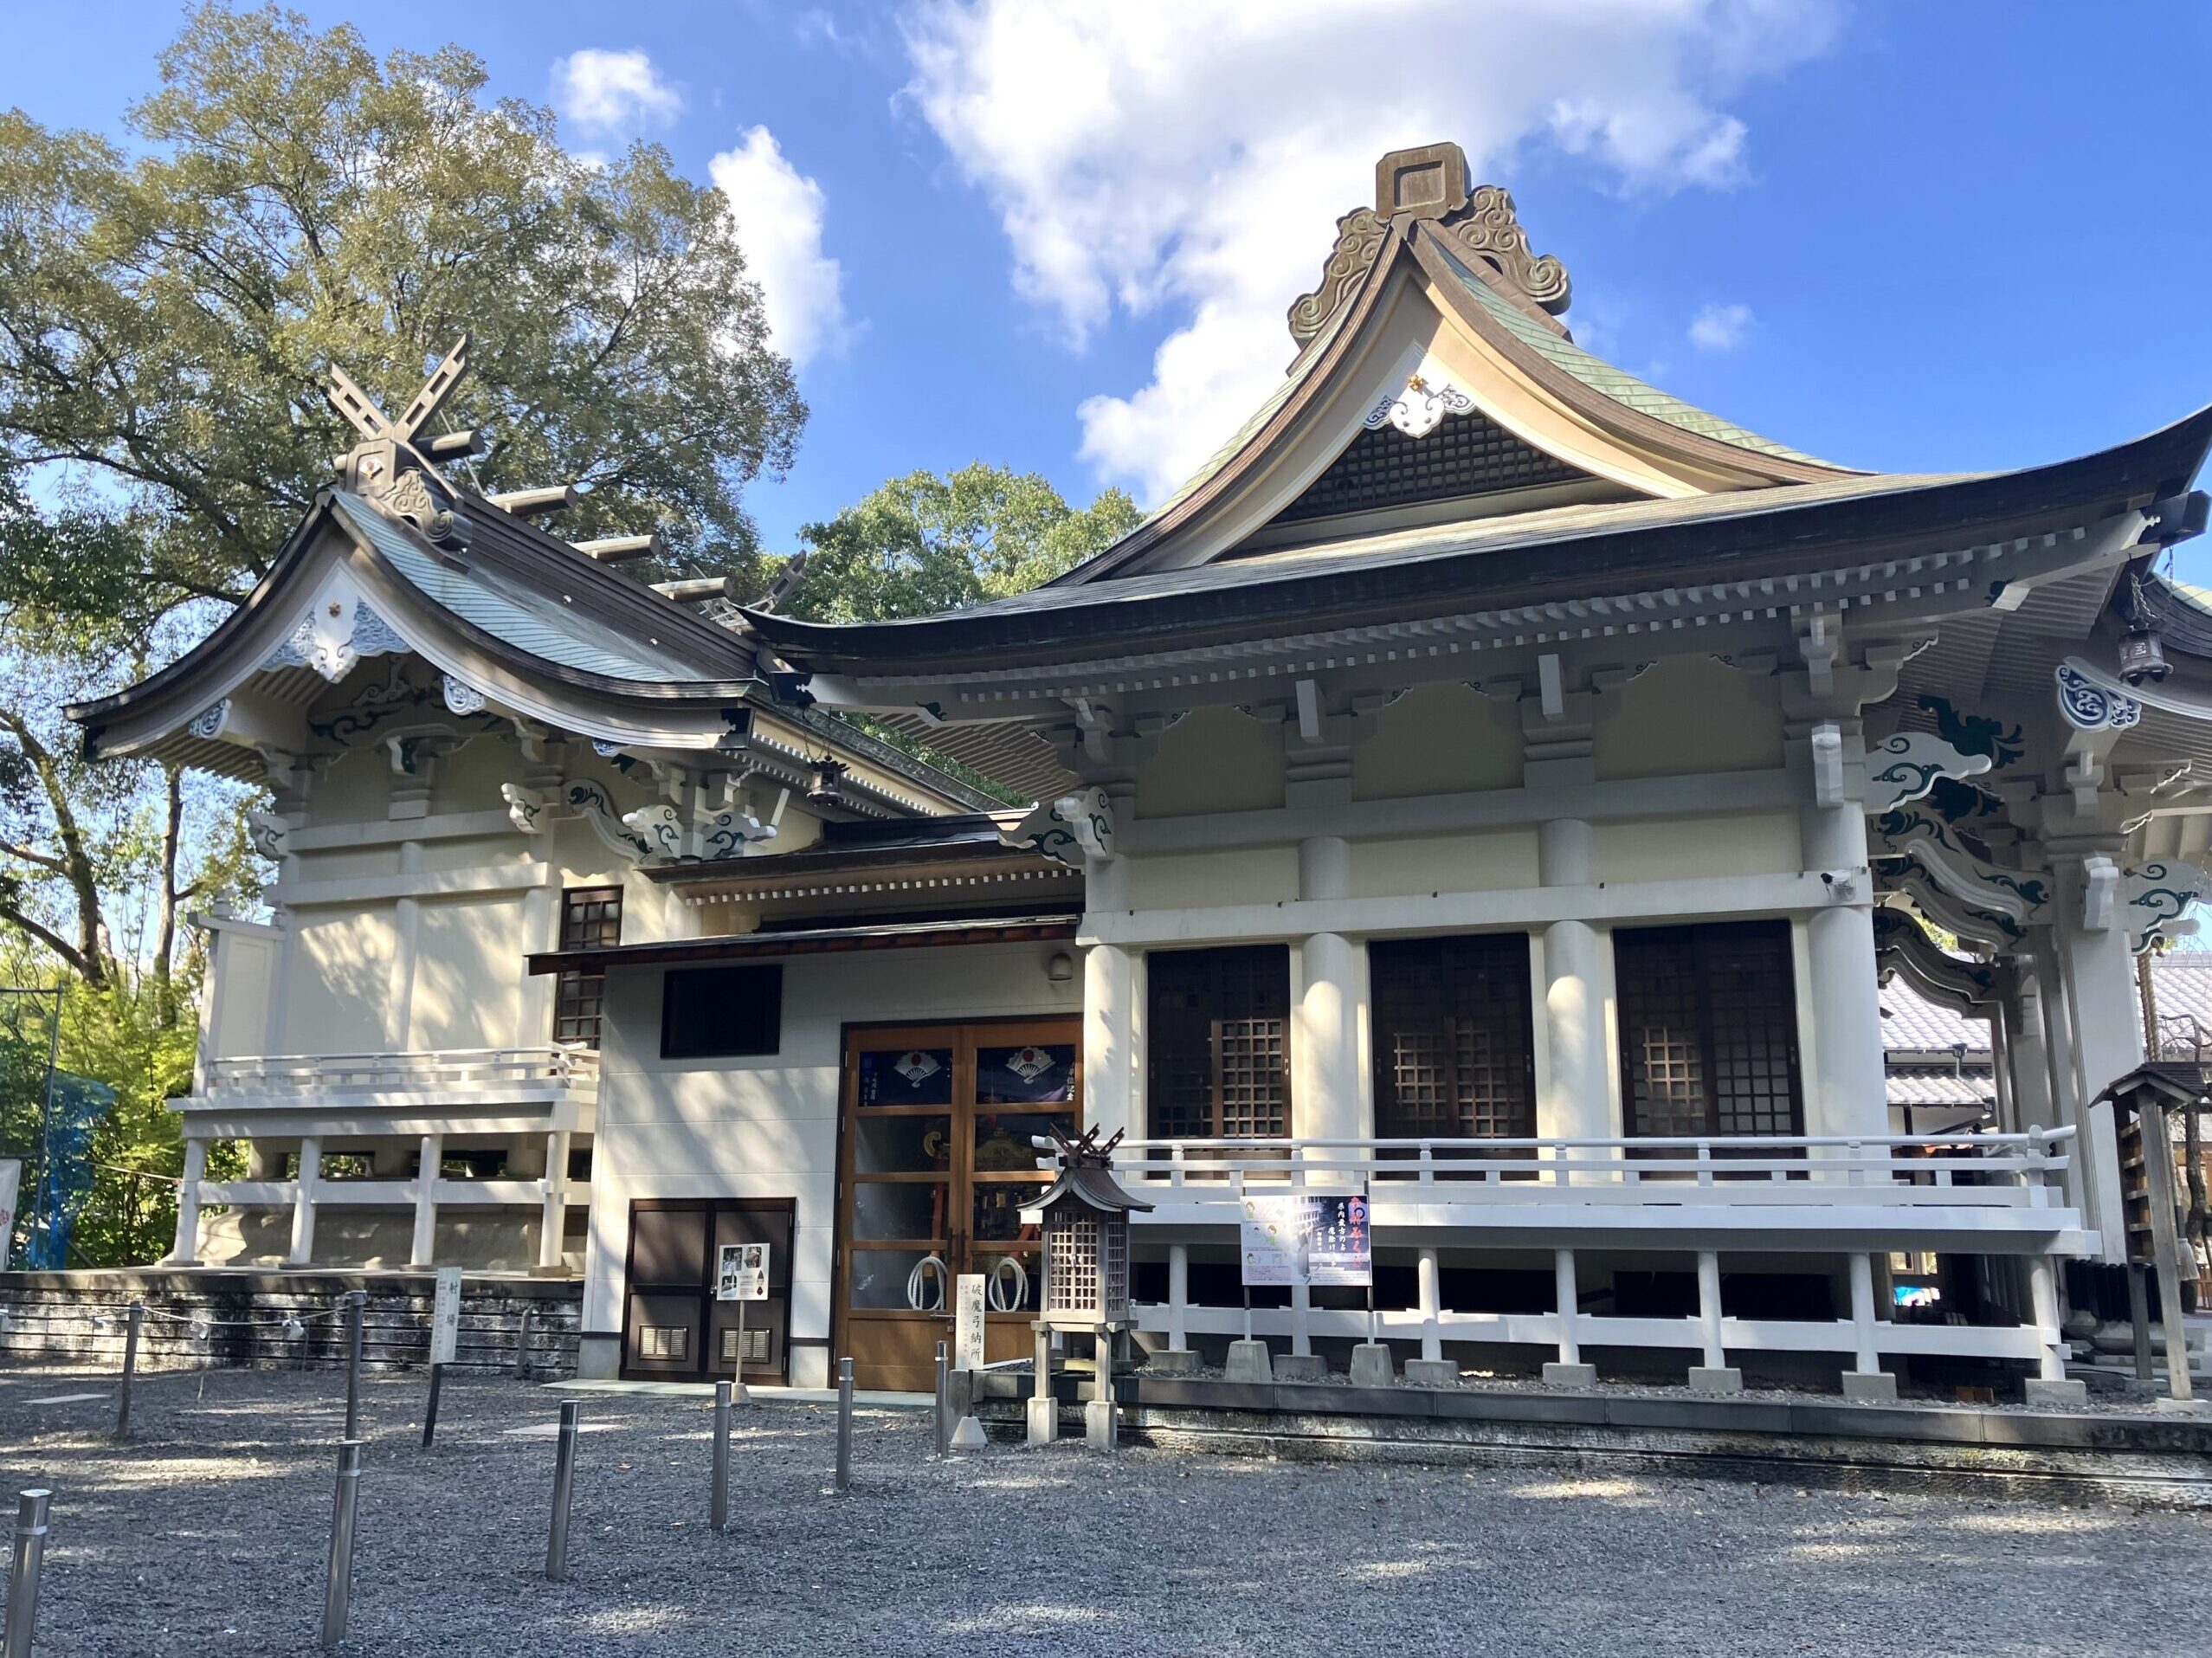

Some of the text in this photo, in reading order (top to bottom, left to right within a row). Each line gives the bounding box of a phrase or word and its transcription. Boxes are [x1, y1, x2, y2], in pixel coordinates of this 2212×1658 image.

[970, 1283, 983, 1363] 破魔弓納所
